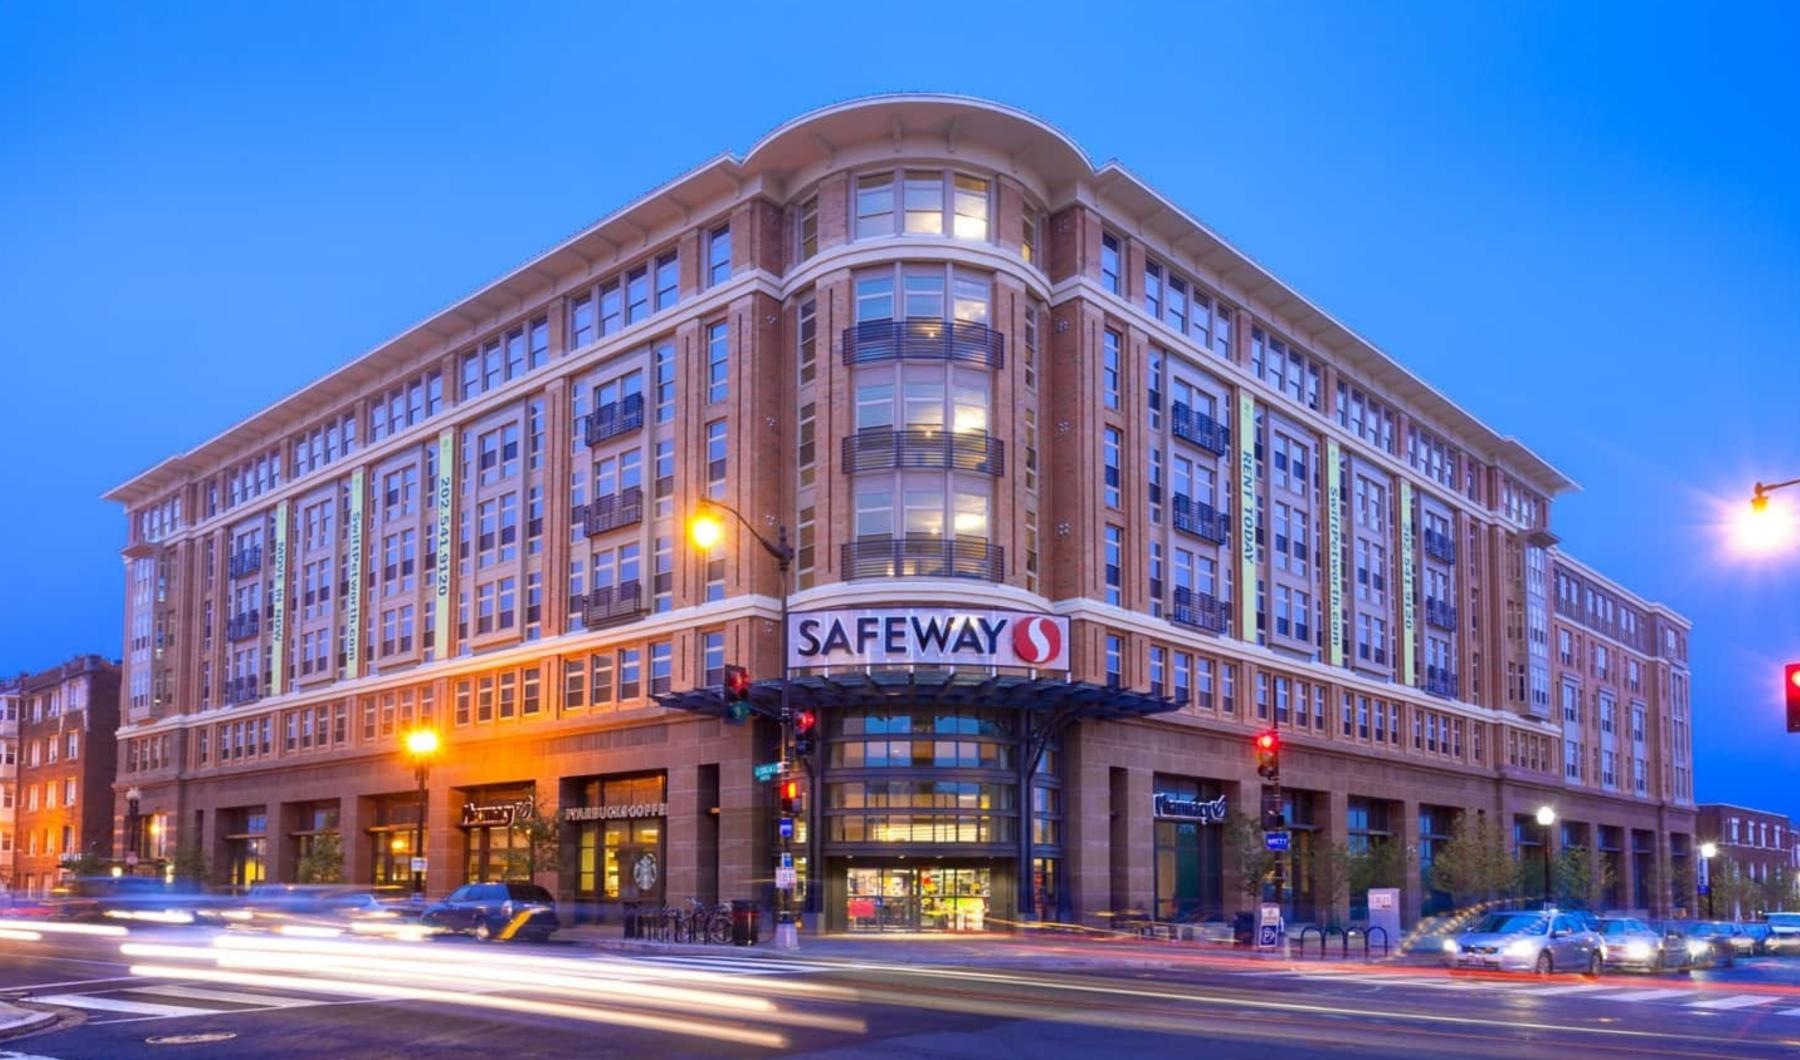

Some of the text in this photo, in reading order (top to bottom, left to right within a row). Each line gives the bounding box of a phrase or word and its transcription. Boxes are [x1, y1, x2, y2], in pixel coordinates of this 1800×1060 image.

[438, 477, 450, 596] 202.541.9120
[1243, 451, 1254, 565] RENT TODAY
[1330, 486, 1339, 646] SwiftPetworth.com
[274, 542, 285, 642] MOVE IN NOW
[348, 511, 360, 661] SwiftPetworth.com
[798, 615, 1007, 657] SAFEWAY
